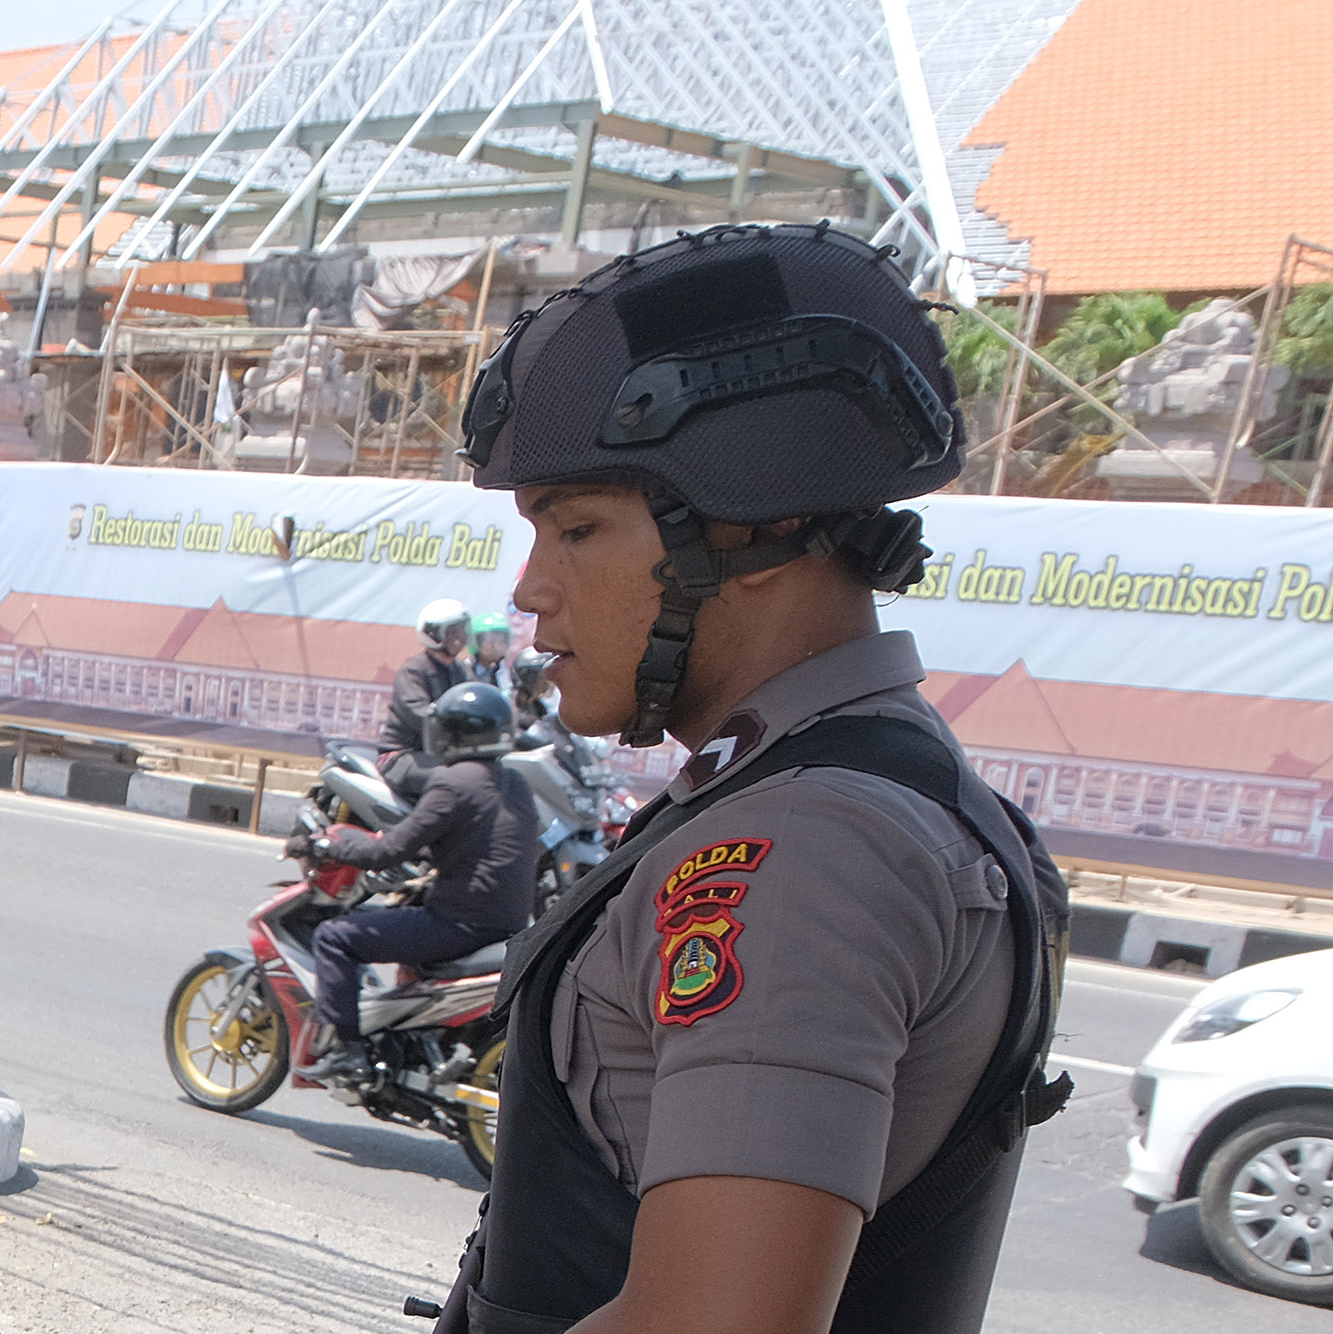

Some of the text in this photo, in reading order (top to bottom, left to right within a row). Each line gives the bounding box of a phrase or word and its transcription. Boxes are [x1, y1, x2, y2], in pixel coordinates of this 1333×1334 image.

[88, 503, 181, 550] Restorasi
[183, 508, 223, 553] dan
[369, 518, 445, 567] Polda
[445, 521, 503, 571] Bali
[957, 548, 1025, 603] dan
[1029, 552, 1267, 619] Modernisasi
[666, 843, 748, 895] POLDA
[664, 888, 738, 917] ALI
